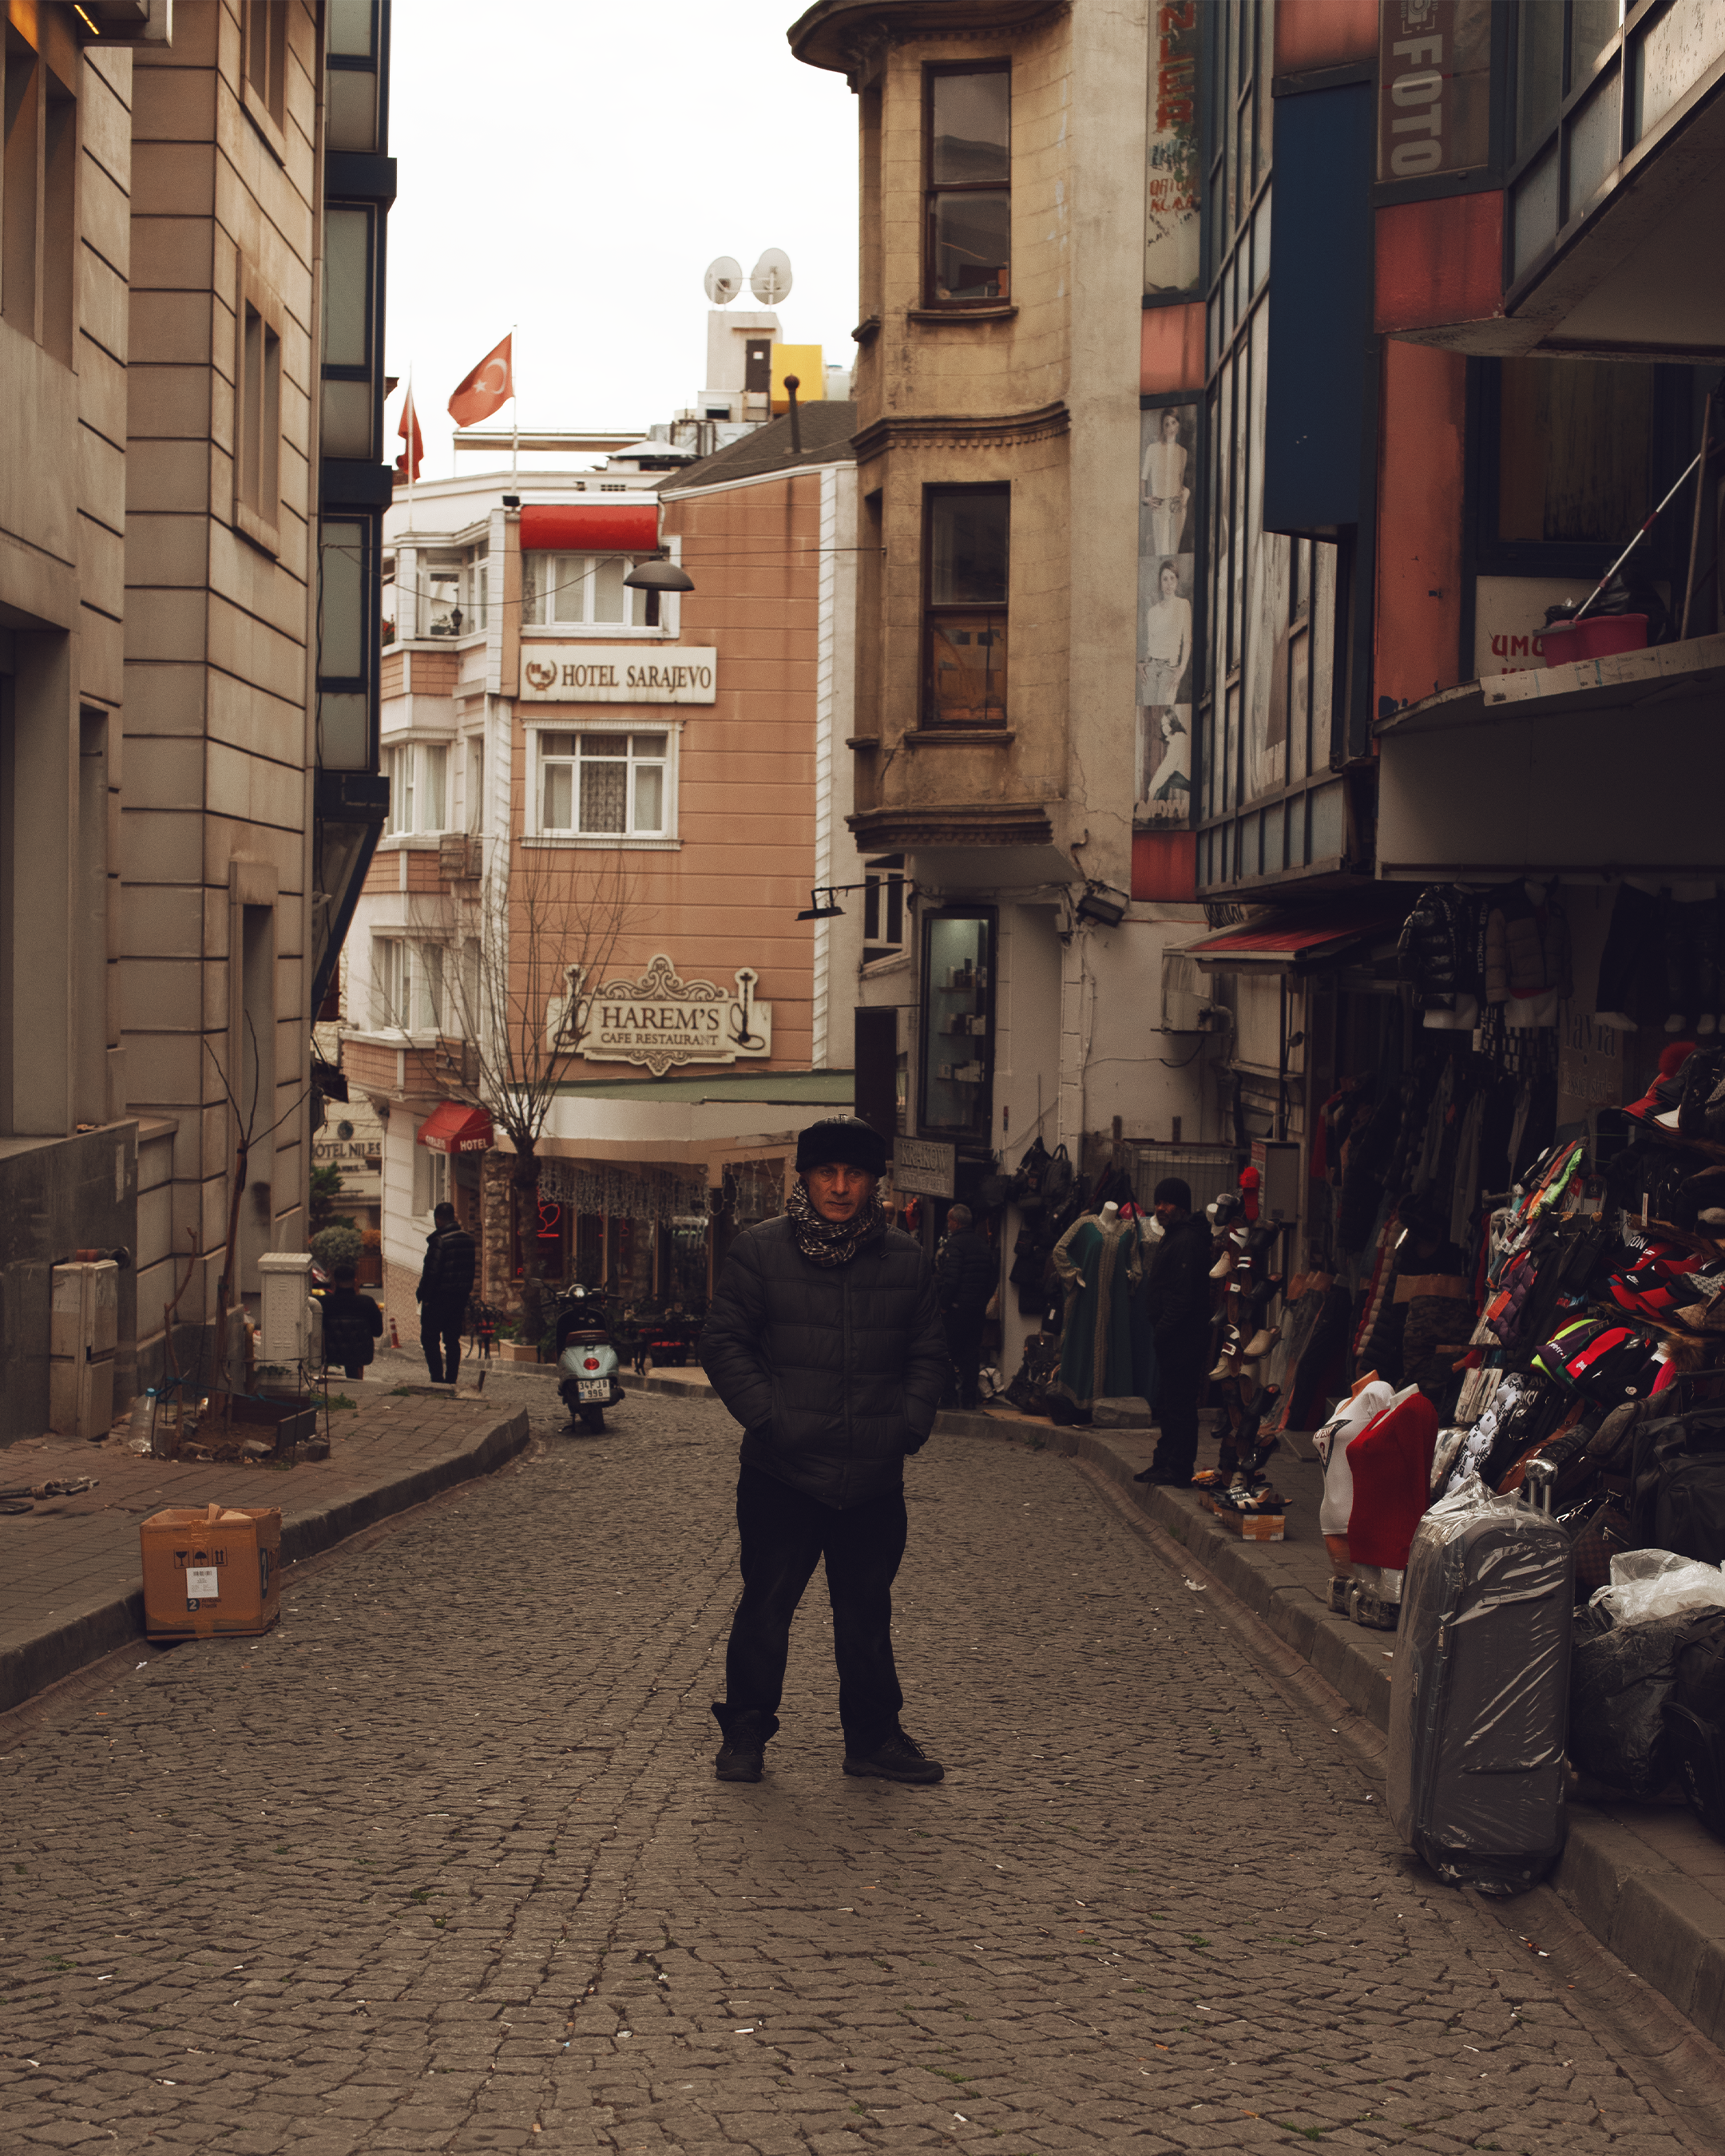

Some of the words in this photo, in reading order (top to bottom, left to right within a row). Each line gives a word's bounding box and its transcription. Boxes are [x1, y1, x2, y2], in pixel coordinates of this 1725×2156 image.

[1390, 34, 1443, 176] FOTO
[561, 664, 620, 687] HOTEL
[626, 665, 712, 693] SARAJEVO
[601, 1032, 632, 1044] CAFE
[636, 1033, 719, 1046] RESTAURANT
[459, 1138, 489, 1151] HOTEL
